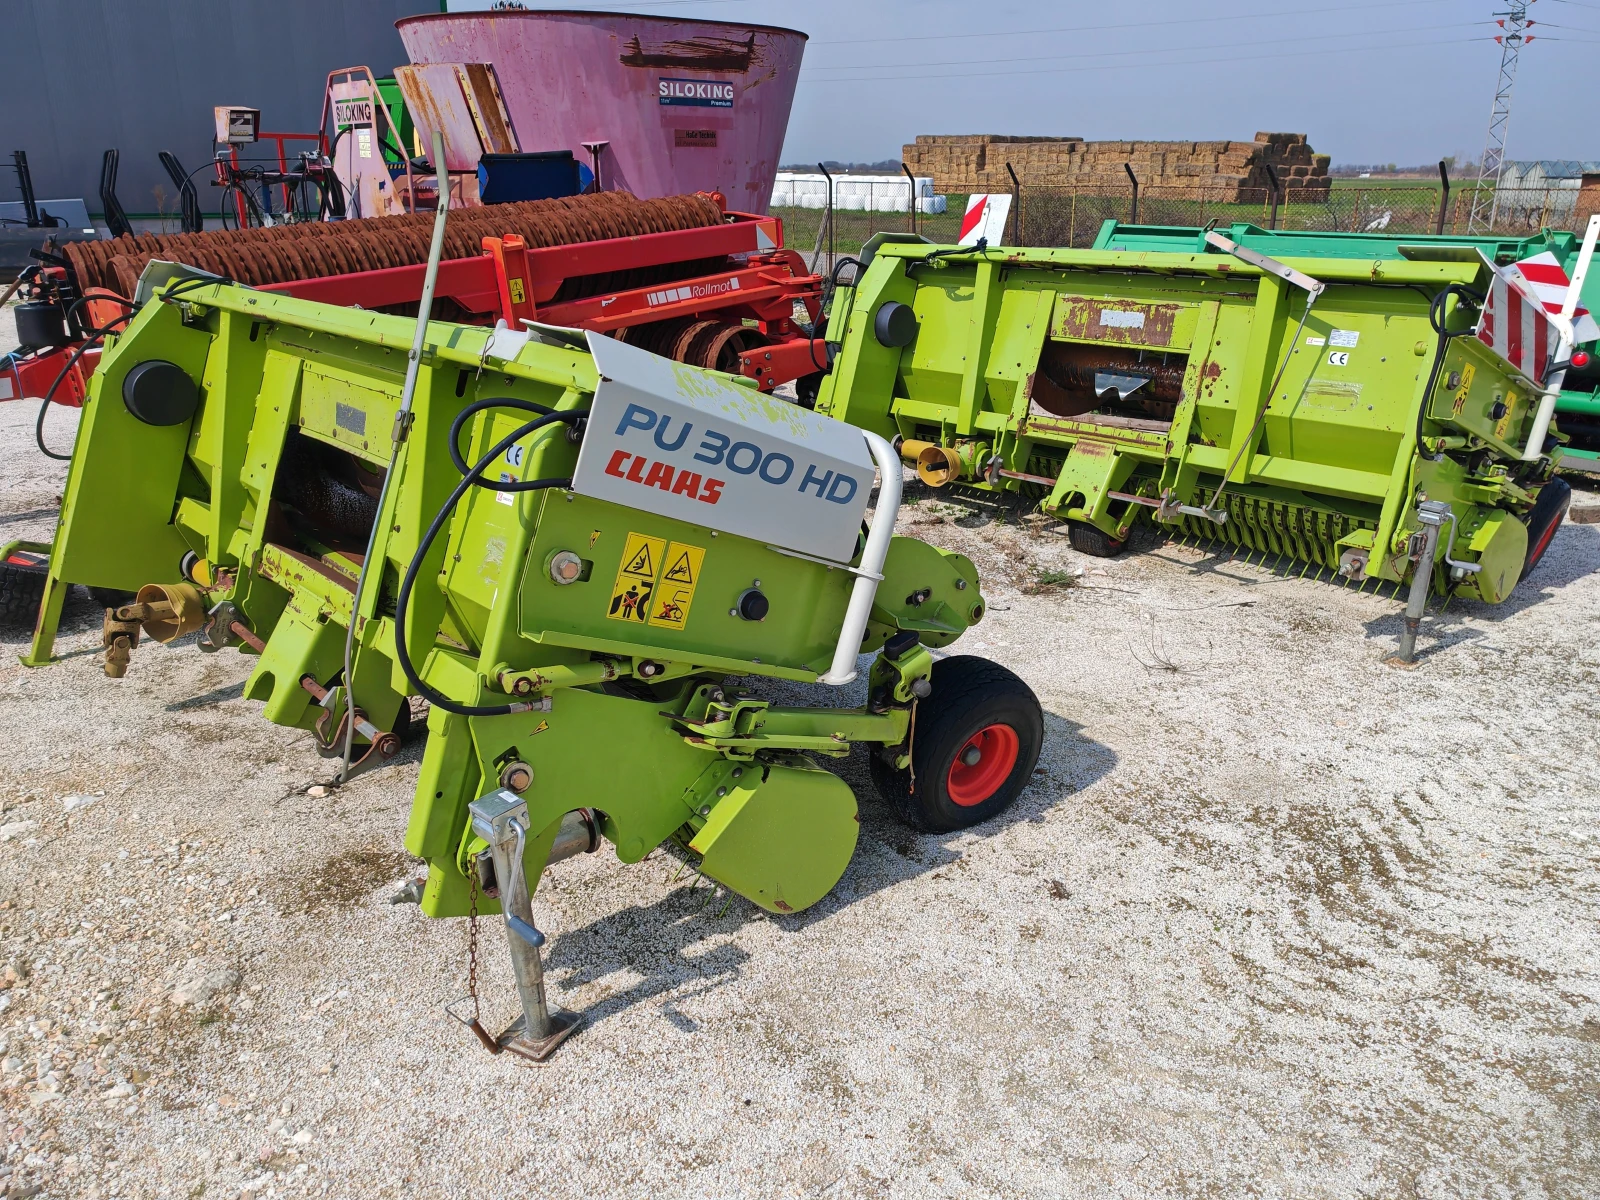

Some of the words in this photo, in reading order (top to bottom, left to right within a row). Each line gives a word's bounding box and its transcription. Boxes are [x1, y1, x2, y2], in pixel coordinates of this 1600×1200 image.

[467, 93, 472, 101] 3
[658, 81, 734, 99] SILOKING
[336, 103, 371, 122] SILOKING
[474, 111, 479, 119] 2
[692, 281, 732, 298] Rollmot
[615, 403, 694, 452] PU
[693, 429, 795, 485] 300
[797, 464, 858, 505] HD
[604, 449, 726, 505] CLAAS
